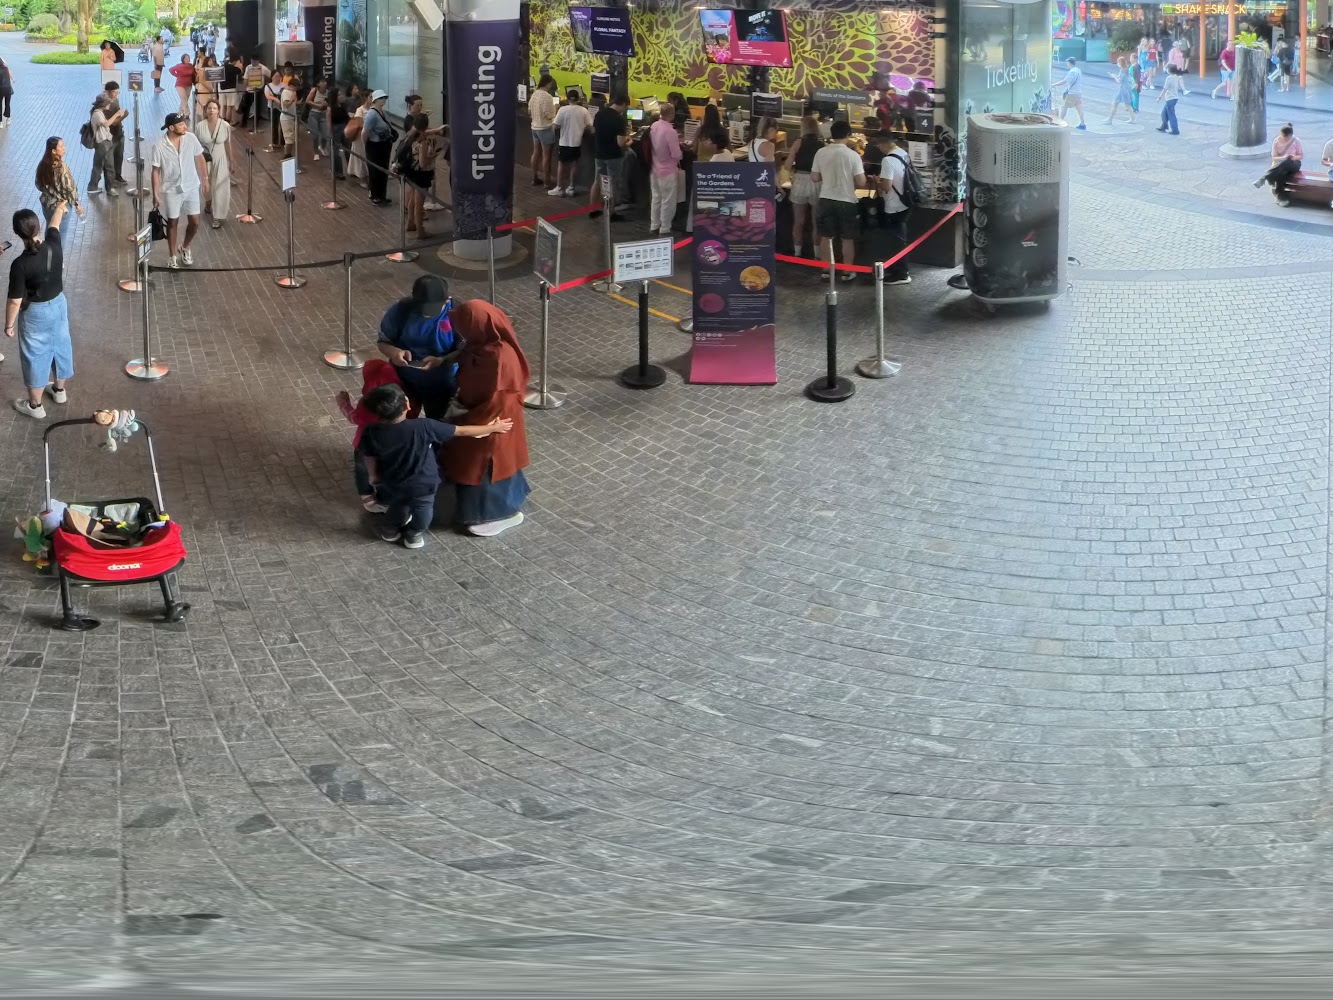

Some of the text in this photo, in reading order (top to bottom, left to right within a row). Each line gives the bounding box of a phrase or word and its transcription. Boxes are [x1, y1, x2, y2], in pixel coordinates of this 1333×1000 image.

[322, 16, 335, 78] Ticketing
[984, 57, 1038, 89] Ticketing
[471, 45, 502, 180] Ticketing
[921, 118, 929, 128] 4
